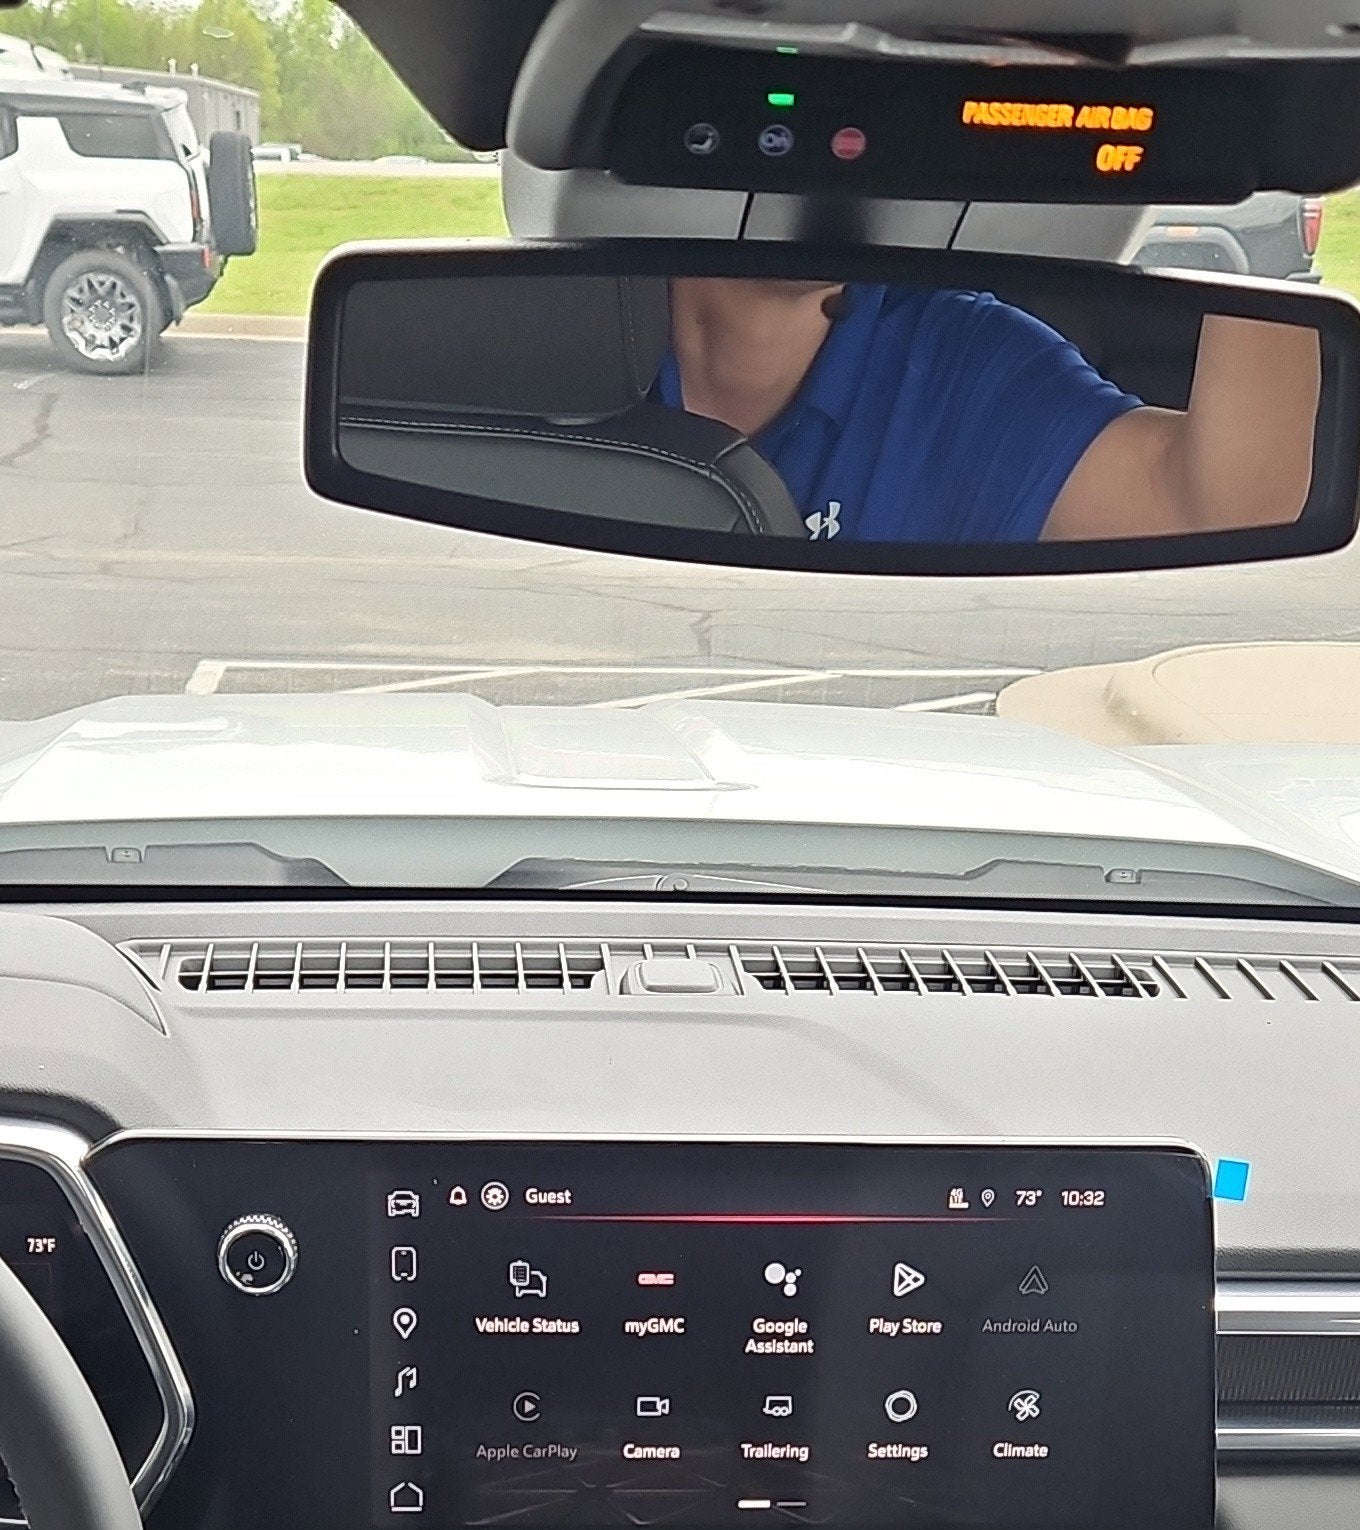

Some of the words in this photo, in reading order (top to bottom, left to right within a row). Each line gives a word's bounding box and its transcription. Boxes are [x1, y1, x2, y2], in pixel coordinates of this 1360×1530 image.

[962, 101, 1075, 127] PASSENGER
[1096, 144, 1144, 172] OFF
[525, 1188, 572, 1204] Guest
[1015, 1190, 1042, 1206] 73°
[1061, 1191, 1105, 1206] 10:32
[26, 1238, 56, 1253] 73°F
[475, 1317, 530, 1333] Vehicle
[532, 1317, 580, 1333] Status
[625, 1318, 685, 1337] myGMC
[753, 1318, 808, 1336] Google
[869, 1318, 900, 1337] Play
[902, 1318, 942, 1334] Store
[981, 1319, 1041, 1333] Android
[1043, 1319, 1078, 1333] Auto
[745, 1339, 814, 1354] Assistant
[476, 1444, 520, 1462] Apple
[523, 1443, 578, 1462] CarPlay
[623, 1443, 681, 1460] Camera
[741, 1443, 809, 1463] Trailering
[868, 1443, 929, 1462] Settings
[992, 1443, 1049, 1459] Climate
